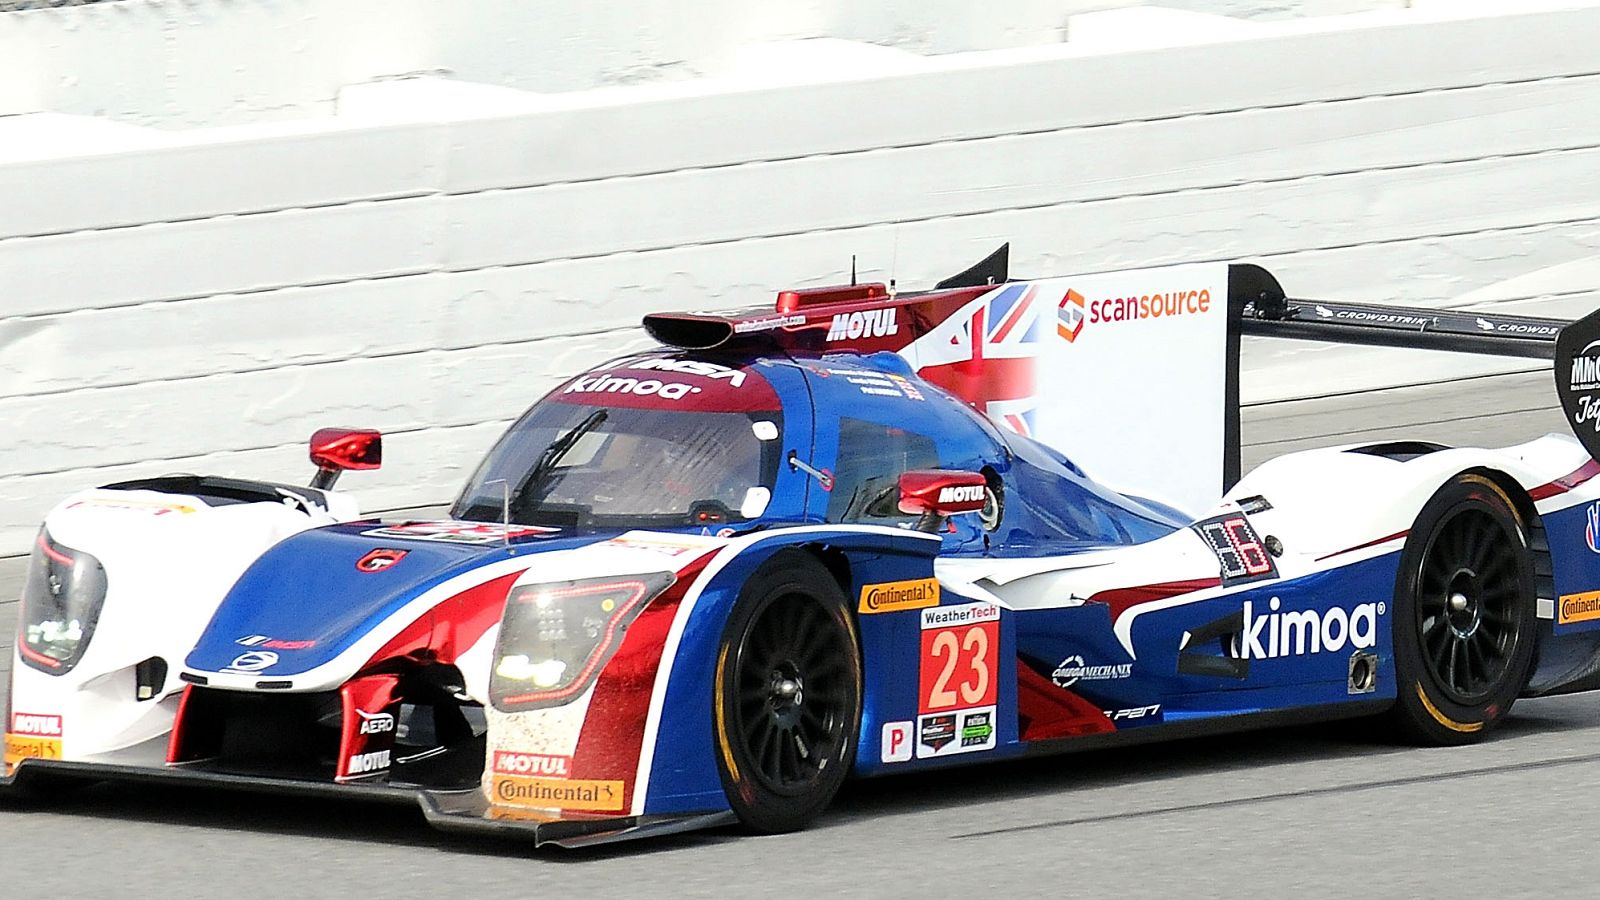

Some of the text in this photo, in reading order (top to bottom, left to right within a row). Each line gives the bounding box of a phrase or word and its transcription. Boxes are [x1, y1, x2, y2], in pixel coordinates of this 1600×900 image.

[1090, 288, 1211, 324] scansource
[1336, 310, 1428, 328] CROWDSTRIK
[826, 308, 898, 342] MOTUL
[563, 373, 692, 400] kimoa
[939, 485, 986, 503] MOTUL
[866, 584, 926, 610] Continental
[924, 605, 997, 625] WeatherTech
[1242, 597, 1378, 660] kimoa
[927, 626, 989, 709] 23
[15, 715, 61, 734] MOTUL
[360, 718, 394, 735] AERO
[890, 728, 904, 755] P
[348, 749, 391, 775] MOTUL
[497, 753, 568, 776] MOTUL
[498, 779, 599, 802] Continental
